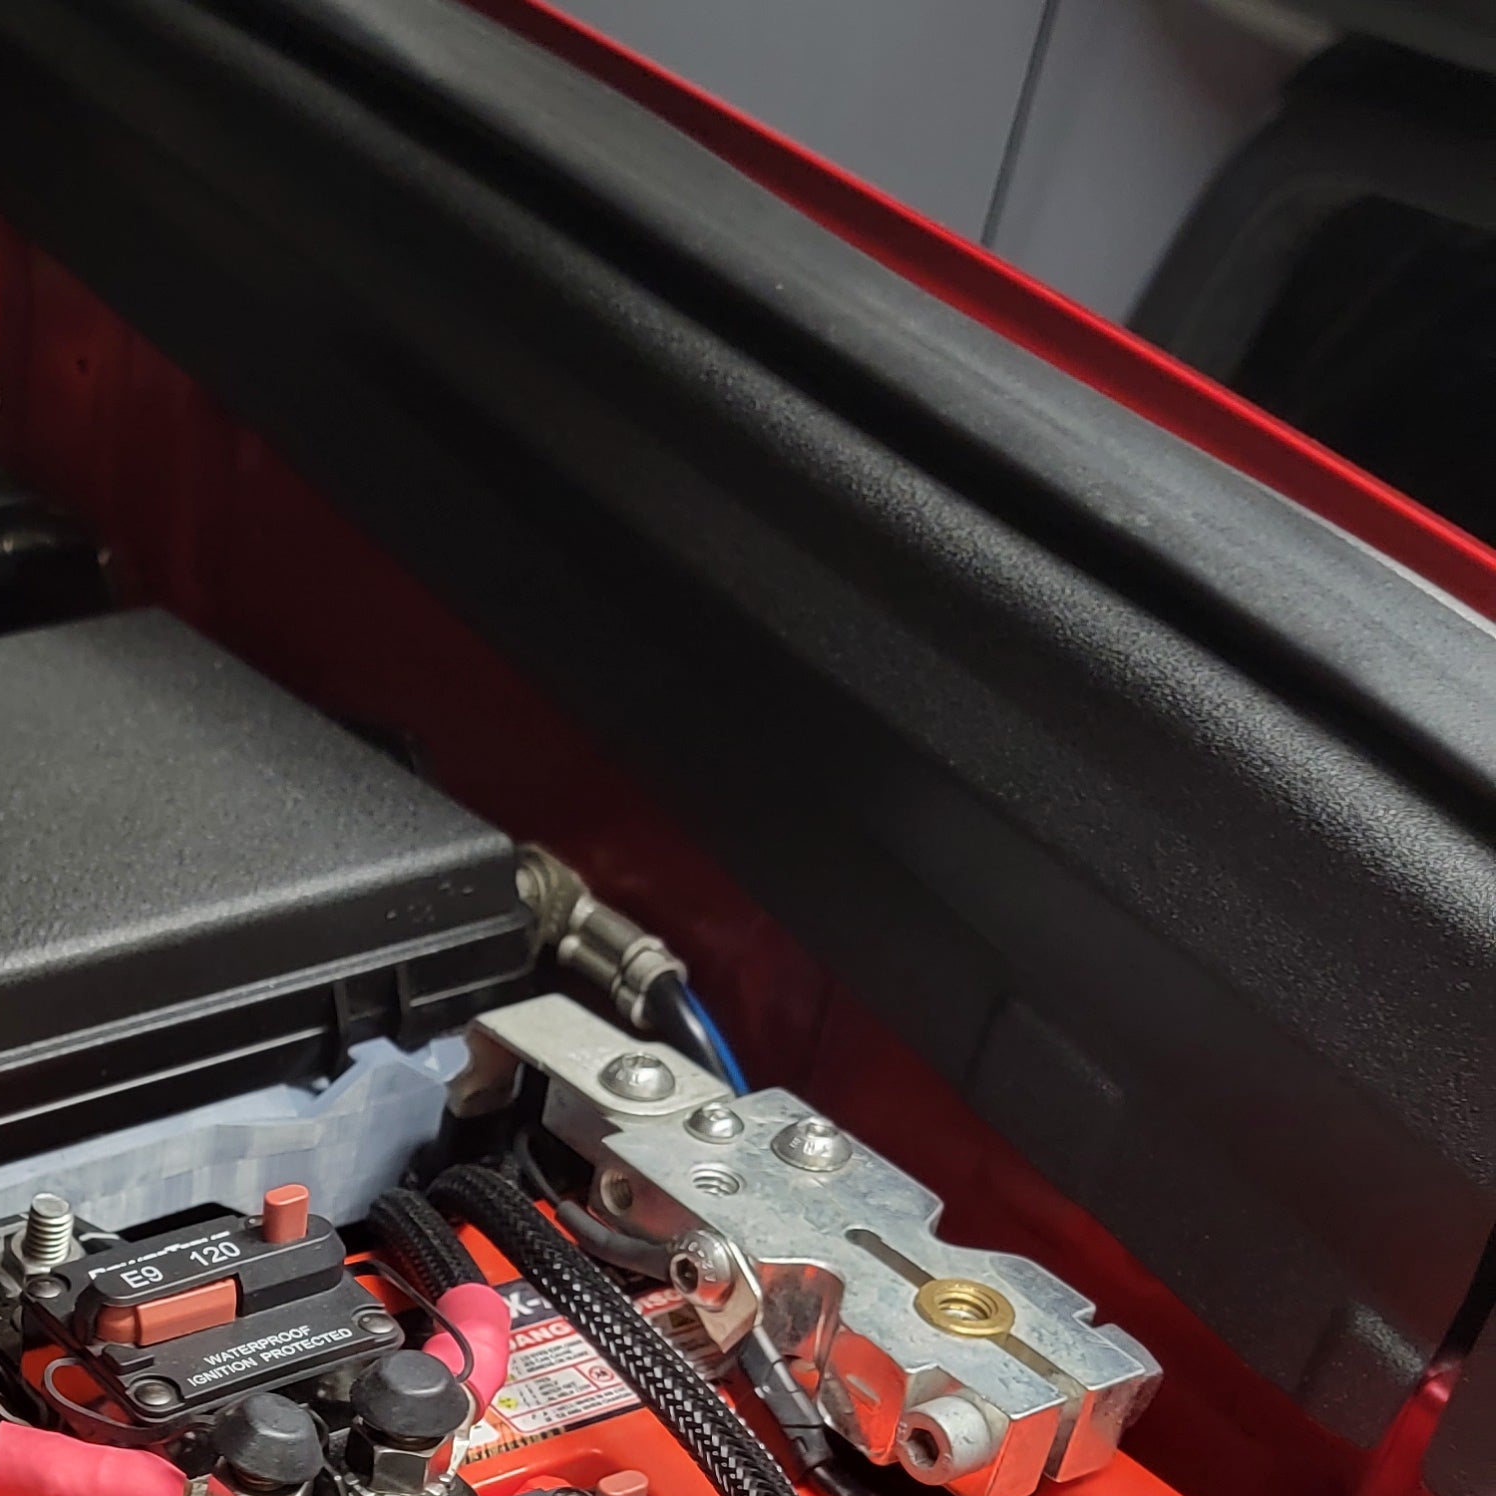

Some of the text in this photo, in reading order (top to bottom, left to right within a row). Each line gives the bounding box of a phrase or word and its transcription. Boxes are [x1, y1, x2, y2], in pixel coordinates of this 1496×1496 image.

[119, 1265, 164, 1289] E9
[190, 1240, 241, 1267] 120
[187, 1327, 353, 1388] IGNITION PROTECTED
[203, 1324, 312, 1367] WATERPROOF
